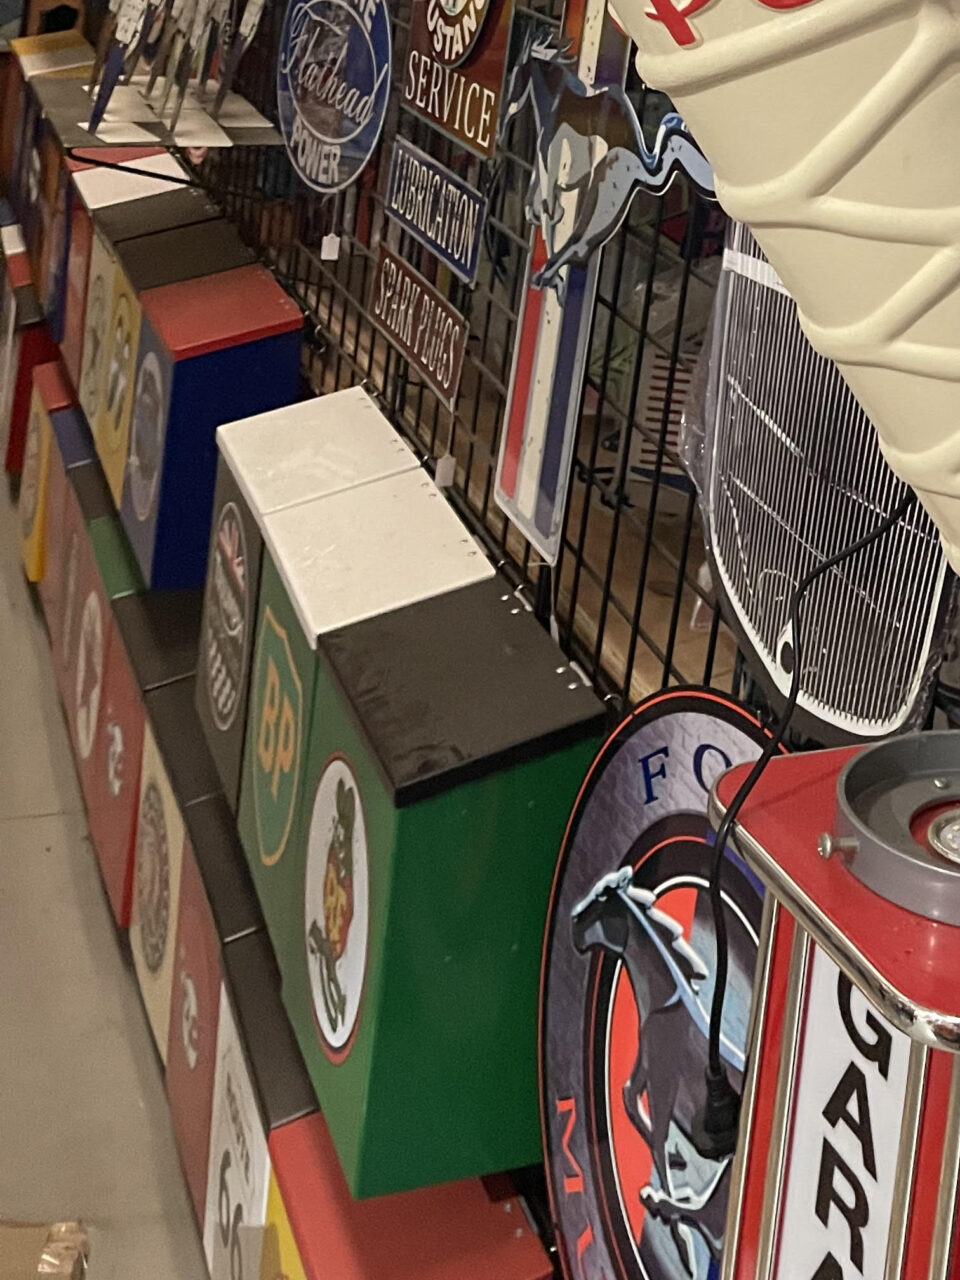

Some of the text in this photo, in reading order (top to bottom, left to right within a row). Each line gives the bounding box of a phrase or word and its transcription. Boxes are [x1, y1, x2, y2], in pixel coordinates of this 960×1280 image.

[281, 2, 389, 126] Flathead
[405, 50, 495, 148] SERVICE
[290, 116, 341, 185] POWER
[391, 149, 480, 269] LUBRICATION
[374, 257, 460, 390] SPARK PLUGS
